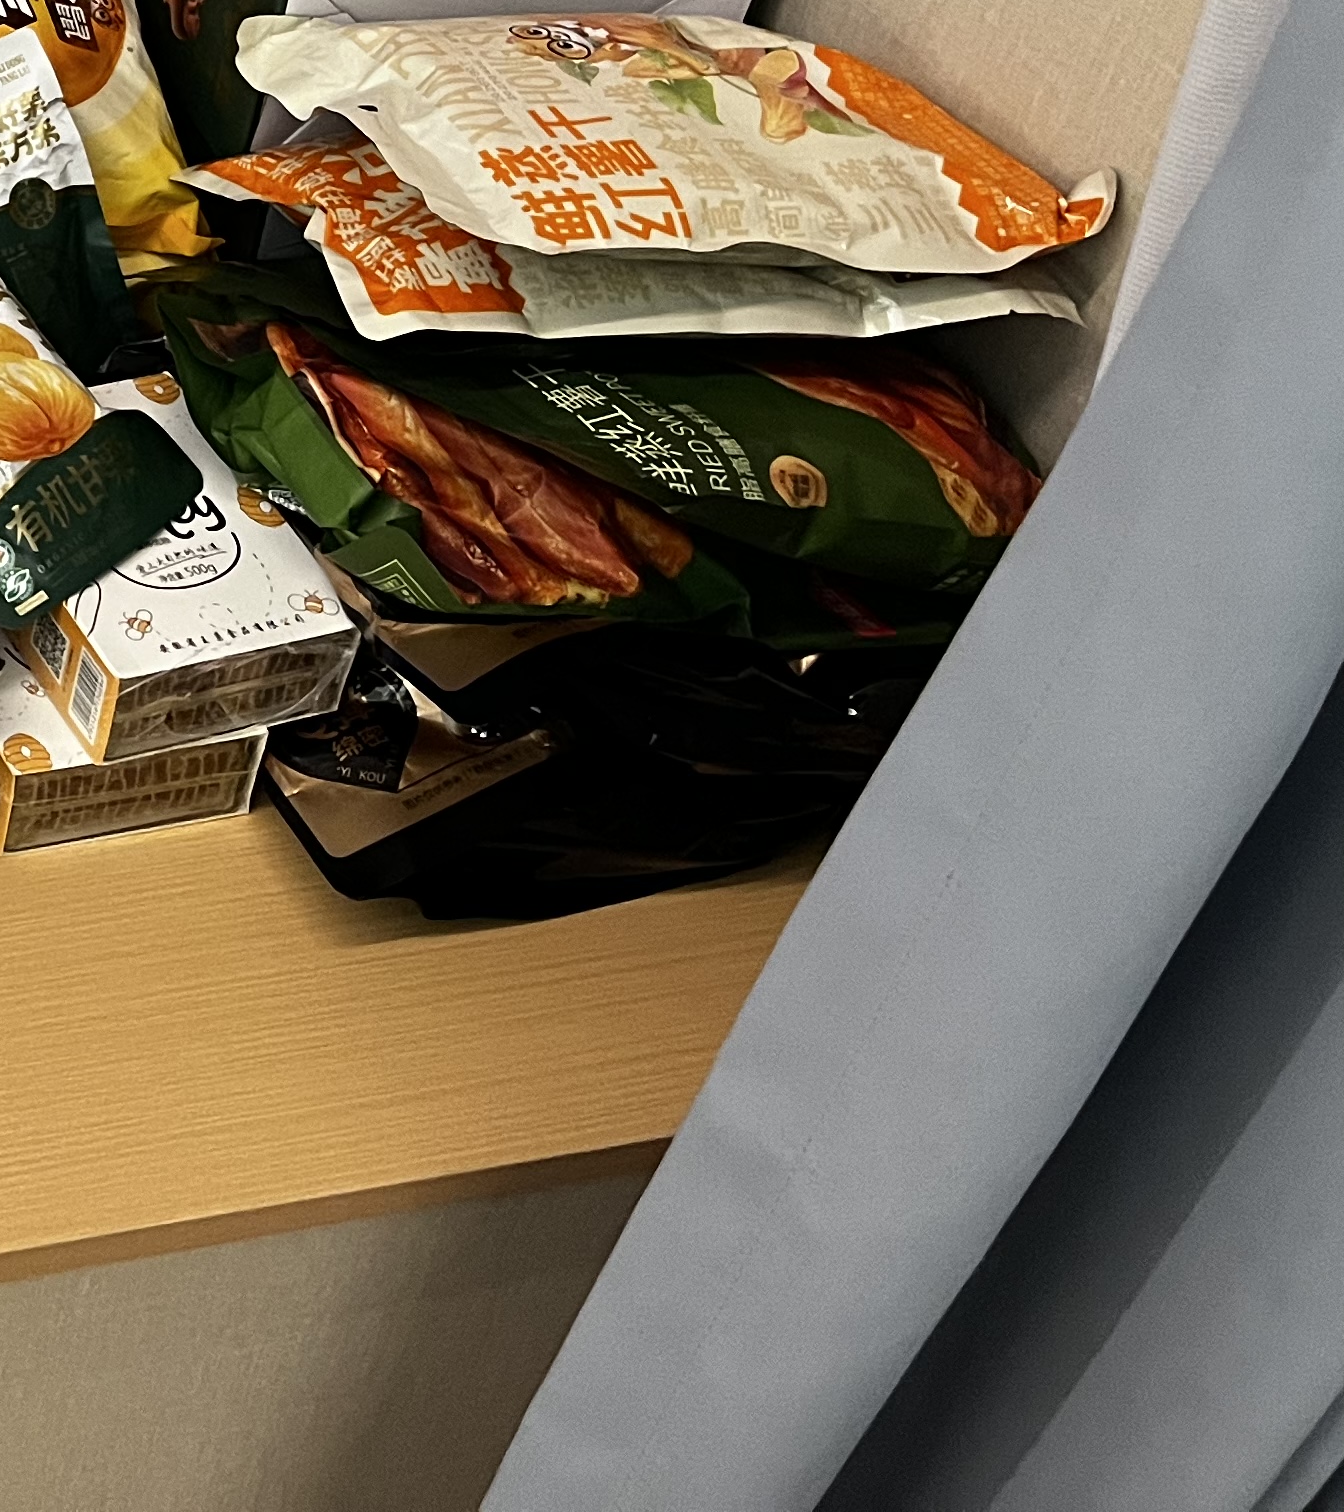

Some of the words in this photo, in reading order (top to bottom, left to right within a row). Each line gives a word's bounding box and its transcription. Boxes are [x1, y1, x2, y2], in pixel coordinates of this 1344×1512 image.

[480, 143, 611, 246] 鲜蒸
[527, 106, 692, 242] 红薯干
[619, 391, 694, 439] SWEET
[358, 767, 385, 783] KOU
